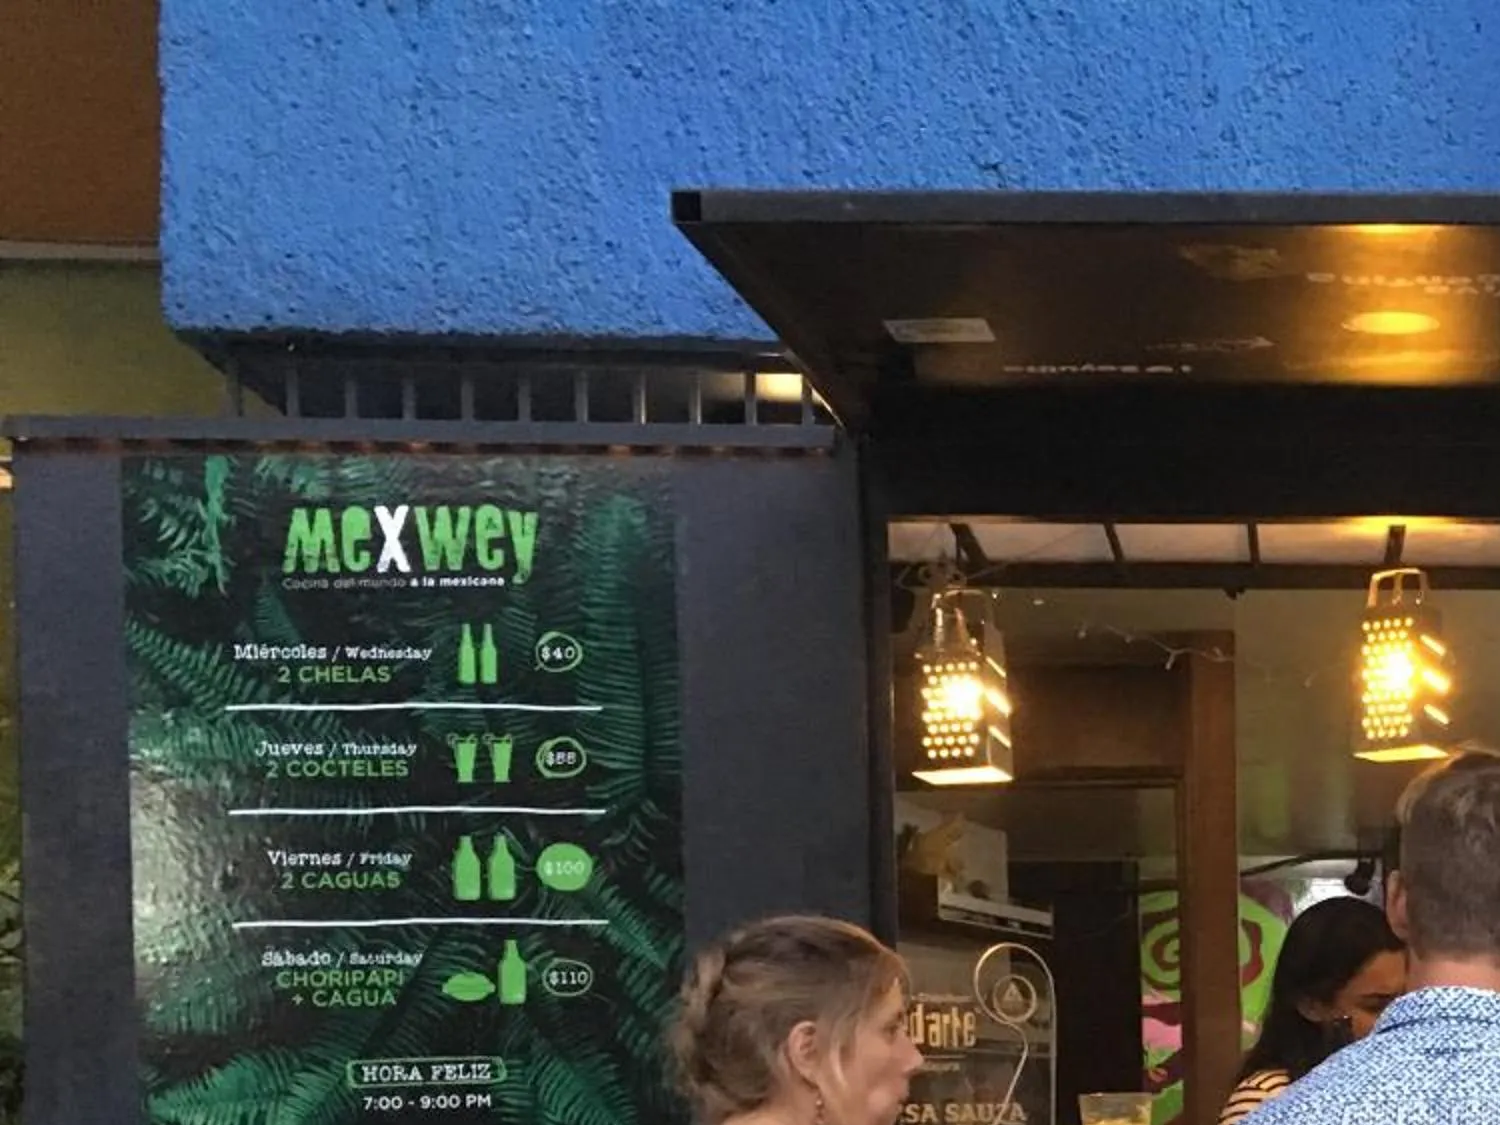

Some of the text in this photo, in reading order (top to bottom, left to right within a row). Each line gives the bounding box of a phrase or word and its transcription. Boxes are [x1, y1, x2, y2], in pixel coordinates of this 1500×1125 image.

[439, 577, 505, 587] mexicana
[233, 643, 326, 660] Miércoles
[345, 646, 433, 662] Wednesday
[541, 644, 576, 662] $40
[278, 666, 392, 683] 2 CHELAS
[255, 741, 324, 757] Jueves
[341, 741, 417, 757] Thursday
[266, 759, 409, 778] 2 COCTELES
[267, 850, 341, 866] Viernes
[359, 852, 413, 866] Friday
[544, 860, 585, 876] $100
[280, 872, 401, 889] 2 CAGUAS
[261, 949, 331, 967] Sábado
[349, 951, 423, 967] Saturday
[548, 968, 589, 987] $110
[312, 990, 397, 1007] CAGUA
[361, 1064, 491, 1082] HORA FELIZ
[363, 1096, 402, 1110] 7:00
[419, 1095, 461, 1110] 9:00
[465, 1093, 491, 1108] PM
